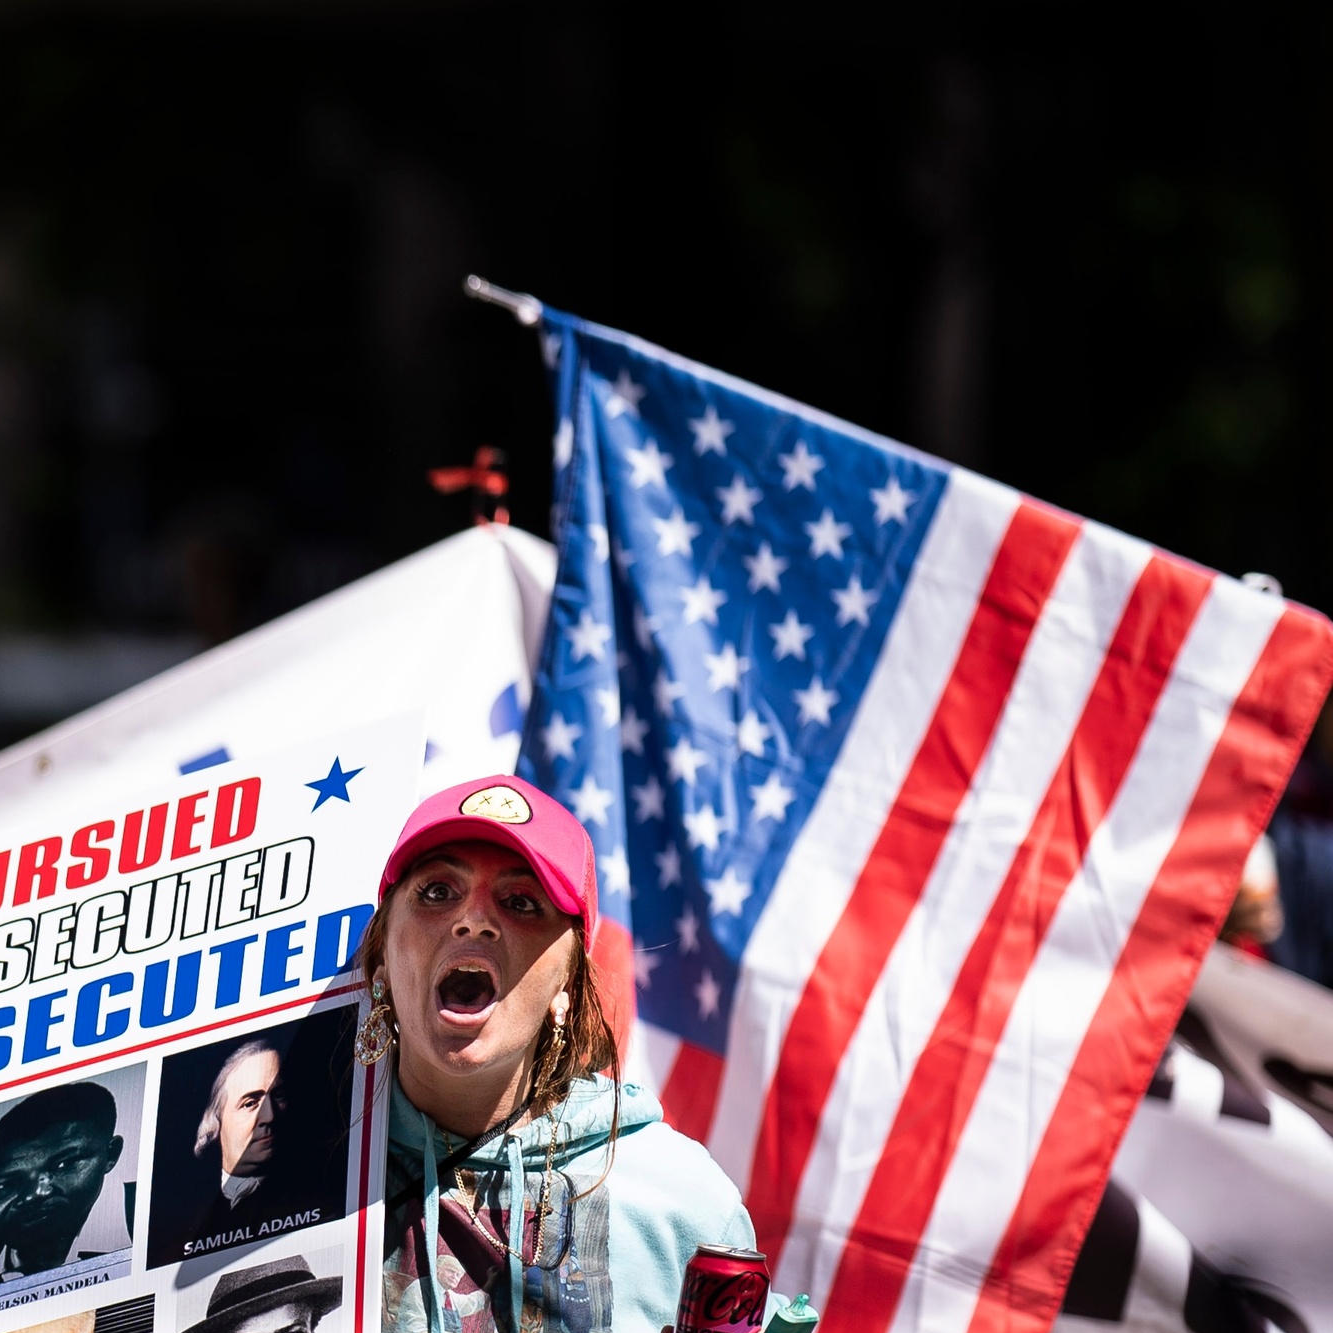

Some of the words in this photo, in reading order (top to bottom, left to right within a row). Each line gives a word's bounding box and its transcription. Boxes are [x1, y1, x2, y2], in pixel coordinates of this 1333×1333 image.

[183, 1226, 254, 1256] SAMUAL
[257, 1208, 321, 1236] ADAMS
[43, 1272, 111, 1298] MANDELA
